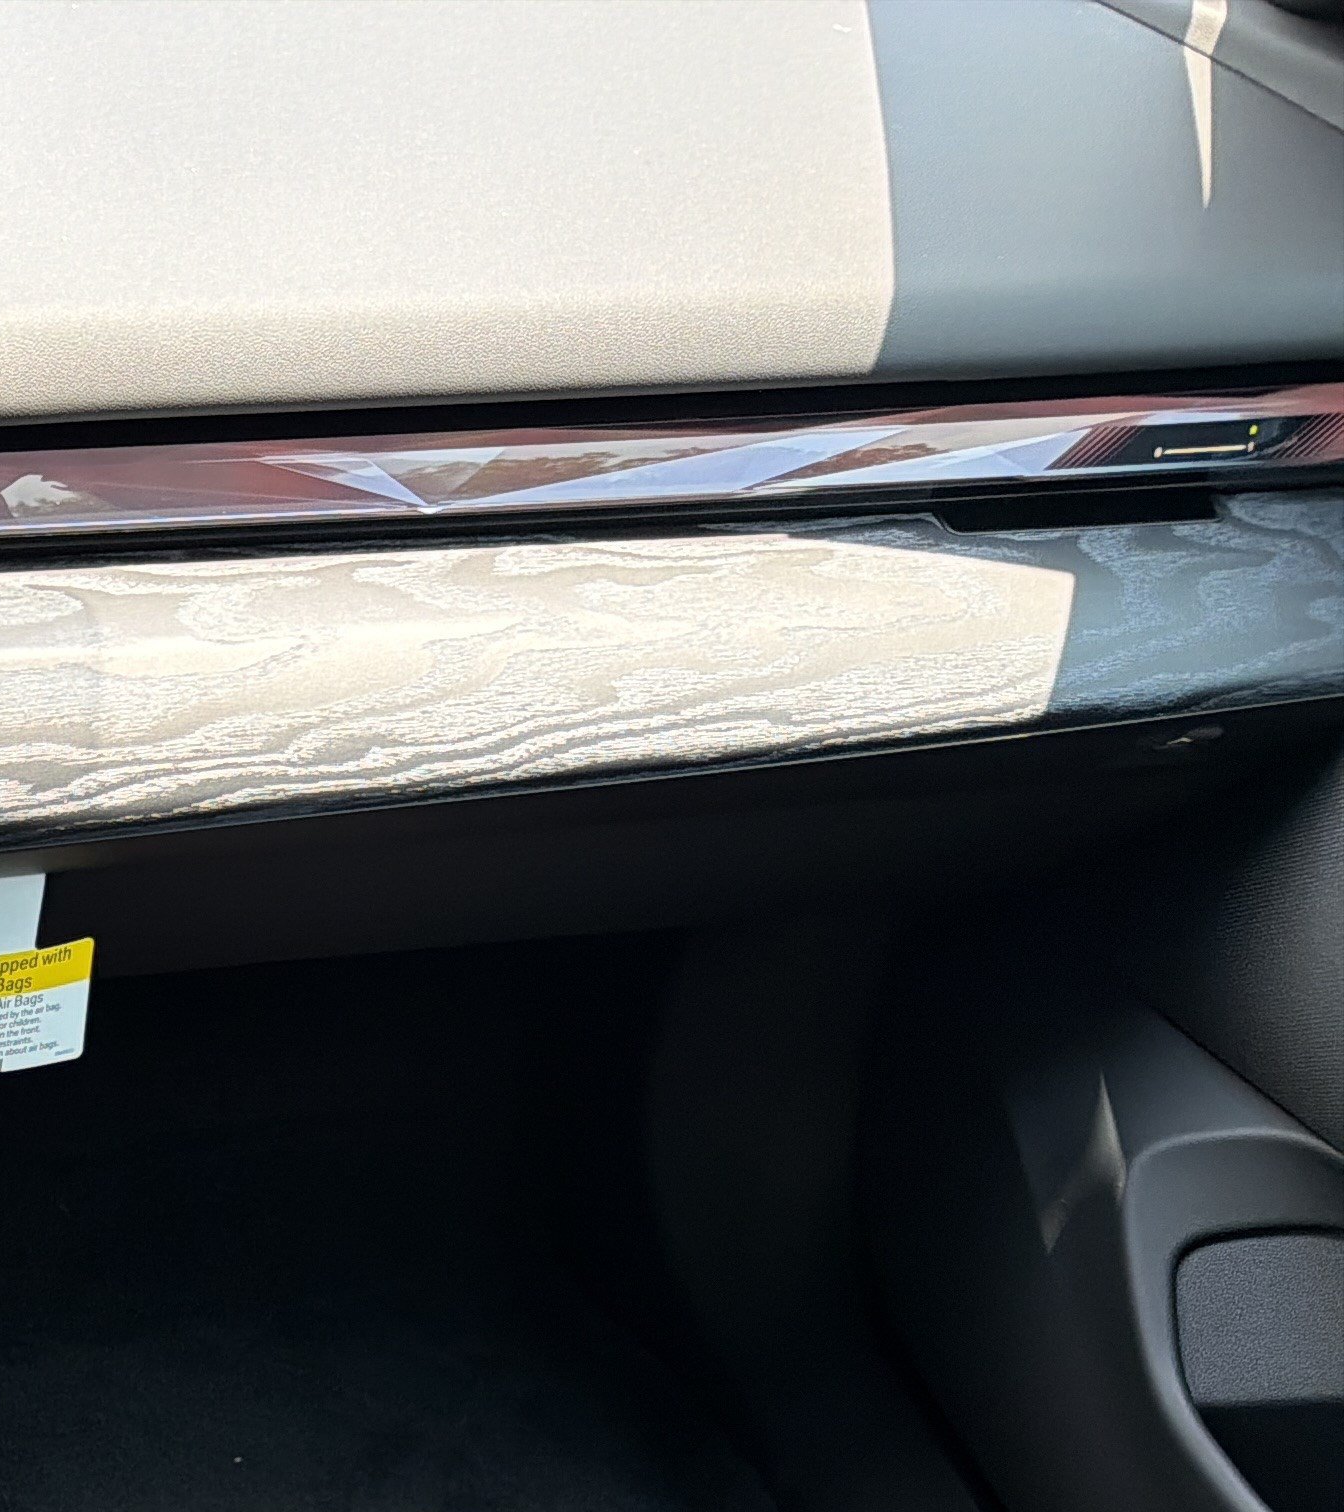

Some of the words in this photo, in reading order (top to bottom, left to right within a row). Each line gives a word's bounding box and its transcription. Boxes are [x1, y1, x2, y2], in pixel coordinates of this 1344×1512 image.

[41, 946, 72, 966] with
[13, 993, 44, 1008] Bags
[10, 1010, 20, 1020] by
[21, 1008, 34, 1016] the
[34, 1006, 45, 1015] air
[6, 1029, 19, 1038] the
[4, 1046, 28, 1057] about
[28, 1044, 38, 1053] air
